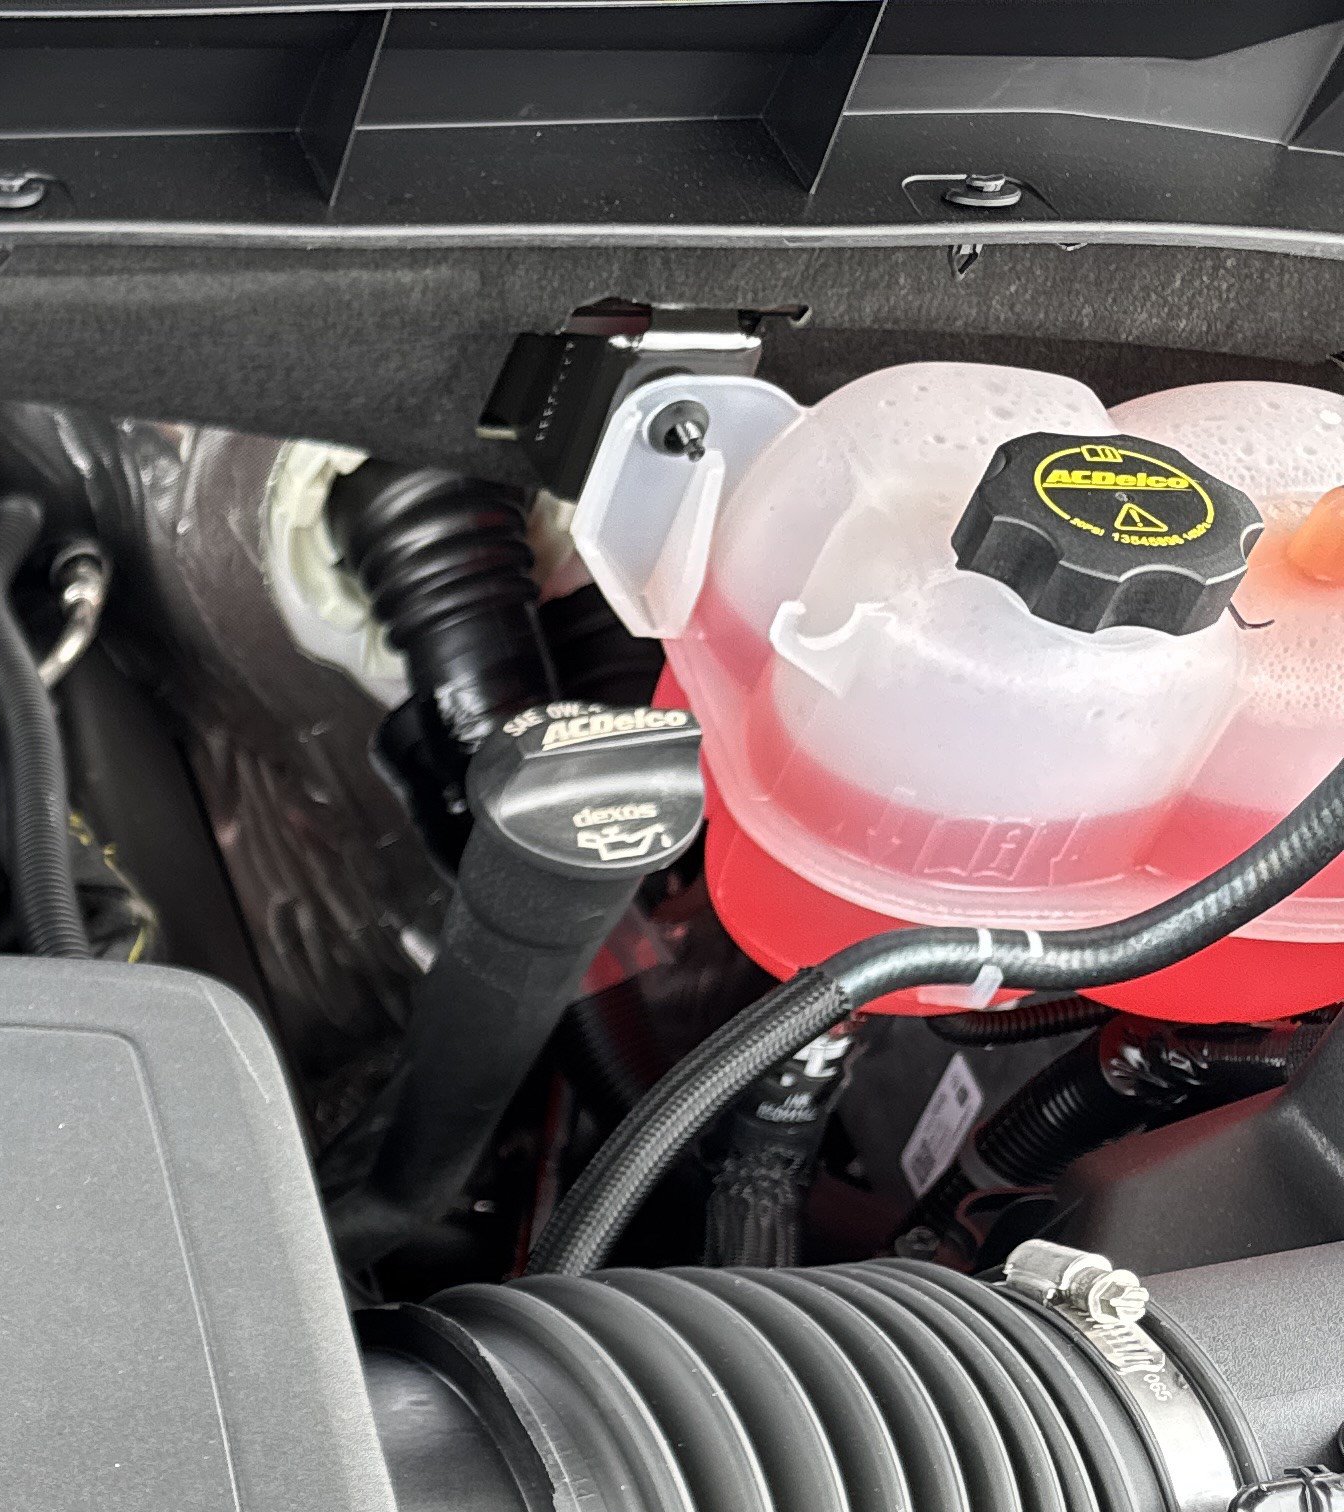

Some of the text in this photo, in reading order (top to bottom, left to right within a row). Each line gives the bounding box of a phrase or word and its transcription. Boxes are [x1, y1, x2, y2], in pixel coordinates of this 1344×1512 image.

[1045, 469, 1190, 489] ACDelco
[502, 707, 546, 737] SAE
[542, 706, 689, 746] ACDelco
[572, 802, 658, 828] dexos
[1143, 1373, 1173, 1402] 065
